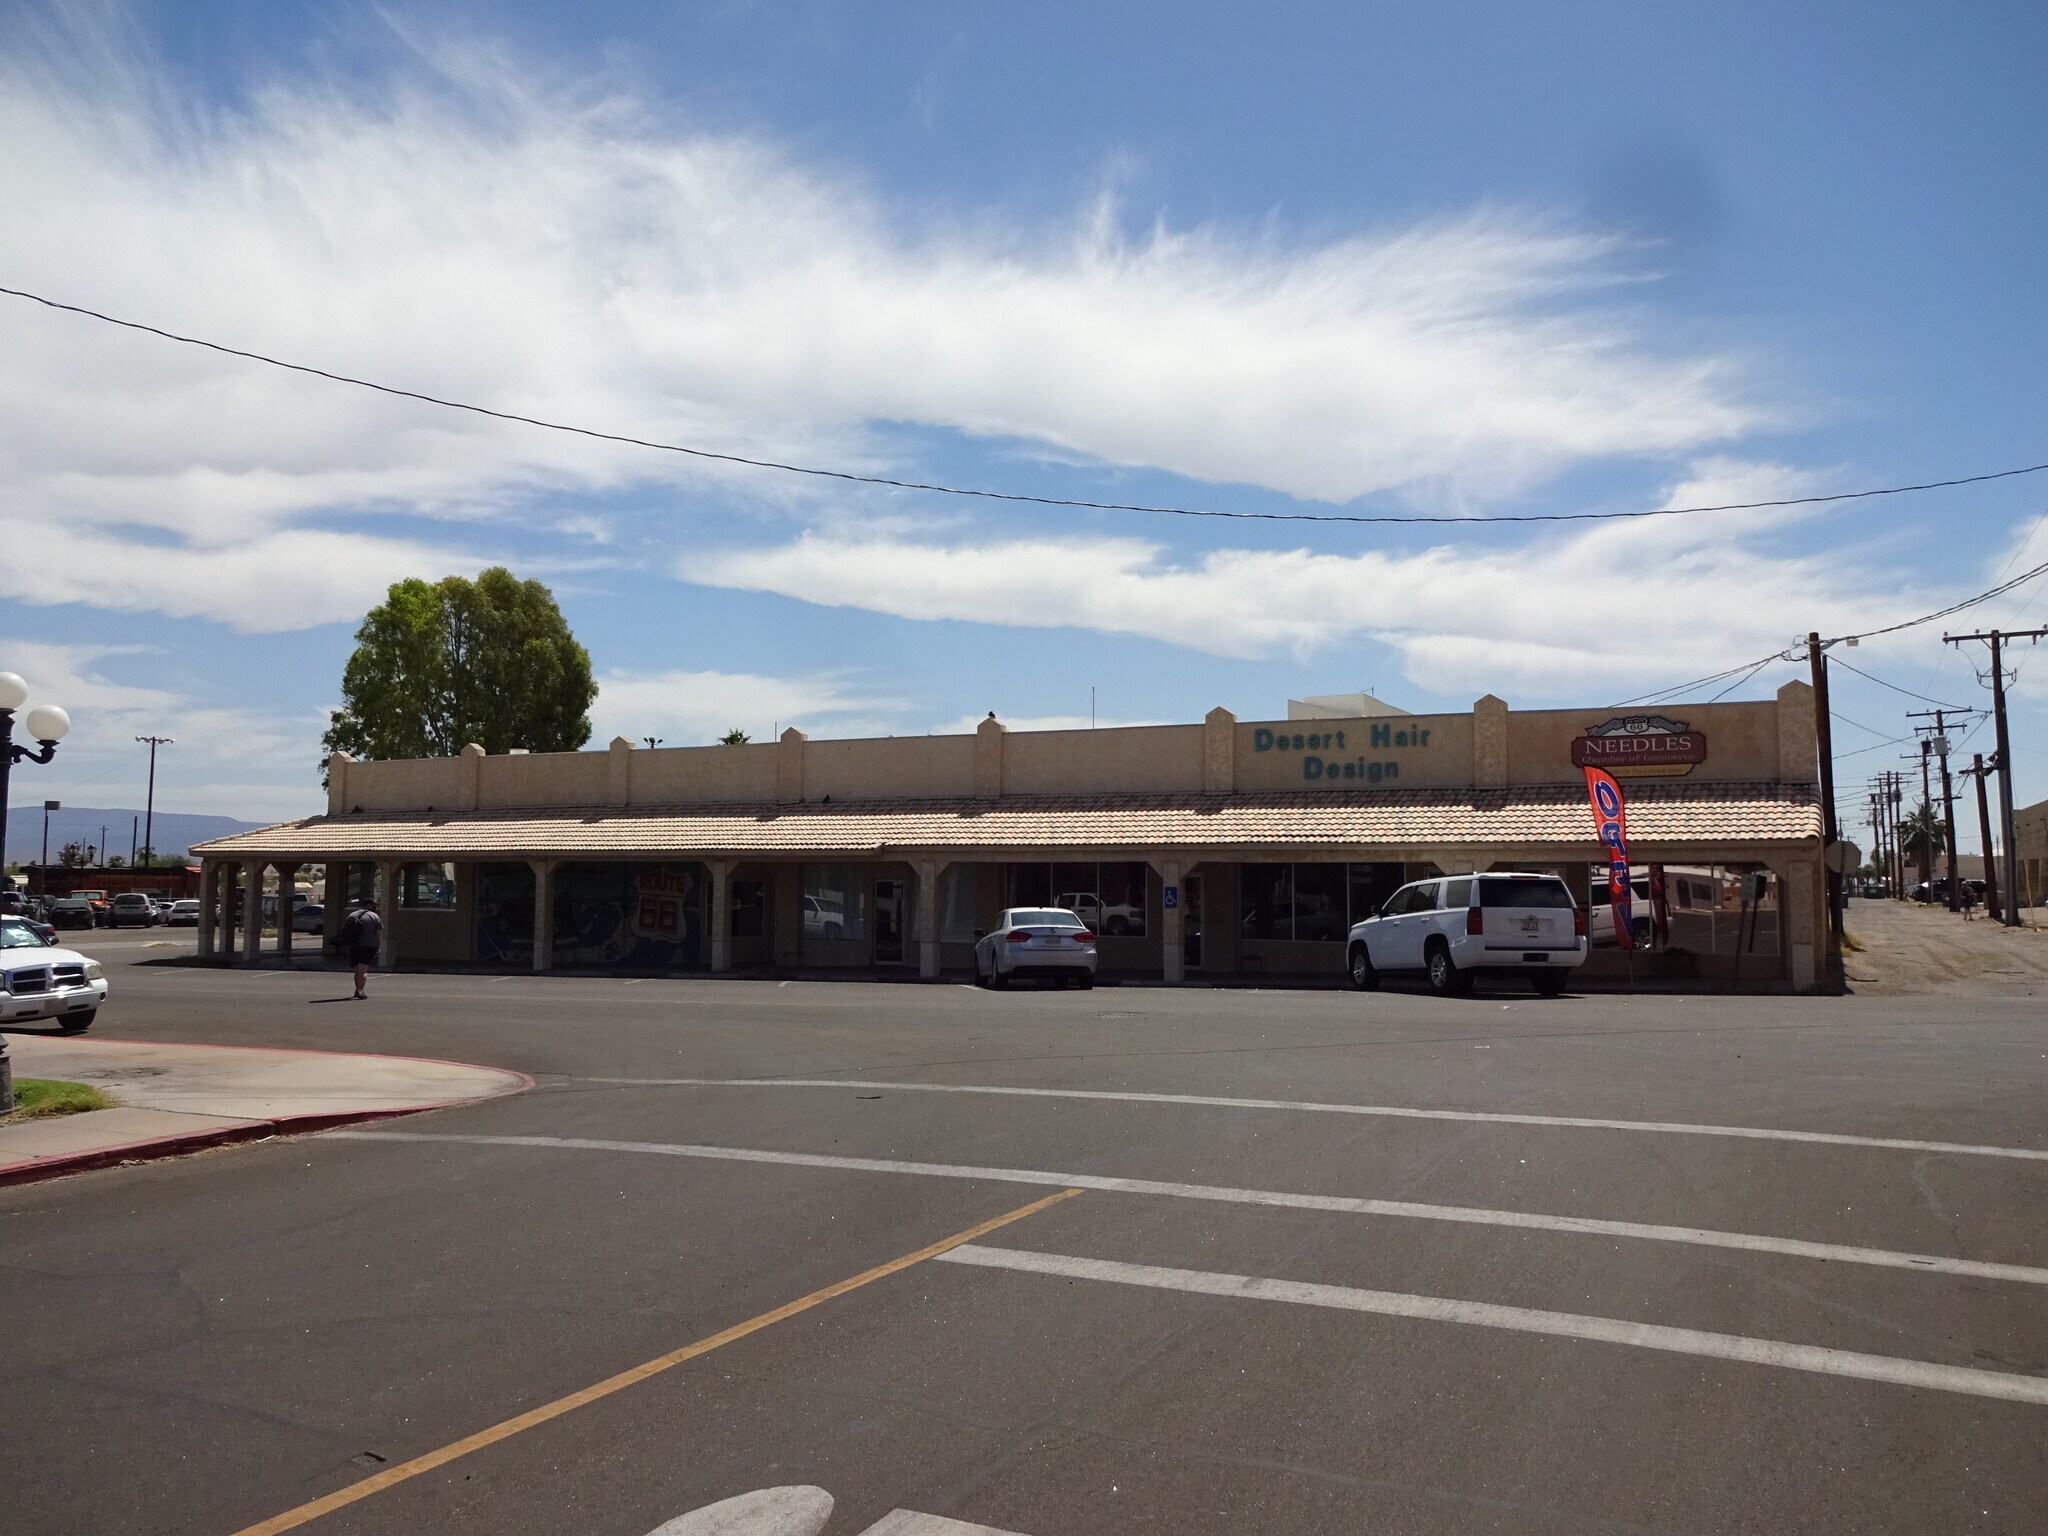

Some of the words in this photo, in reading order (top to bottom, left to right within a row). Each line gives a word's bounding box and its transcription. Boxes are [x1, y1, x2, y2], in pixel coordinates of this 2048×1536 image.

[1254, 727, 1345, 752] Desert
[1371, 723, 1431, 748] Hair
[1585, 736, 1691, 753] NEEDLES
[1303, 756, 1399, 782] Design
[1582, 755, 1625, 764] Chamber
[1629, 754, 1639, 762] of
[1643, 753, 1695, 762] Commerce
[639, 870, 686, 893] ROUTE
[639, 898, 677, 931] 66
